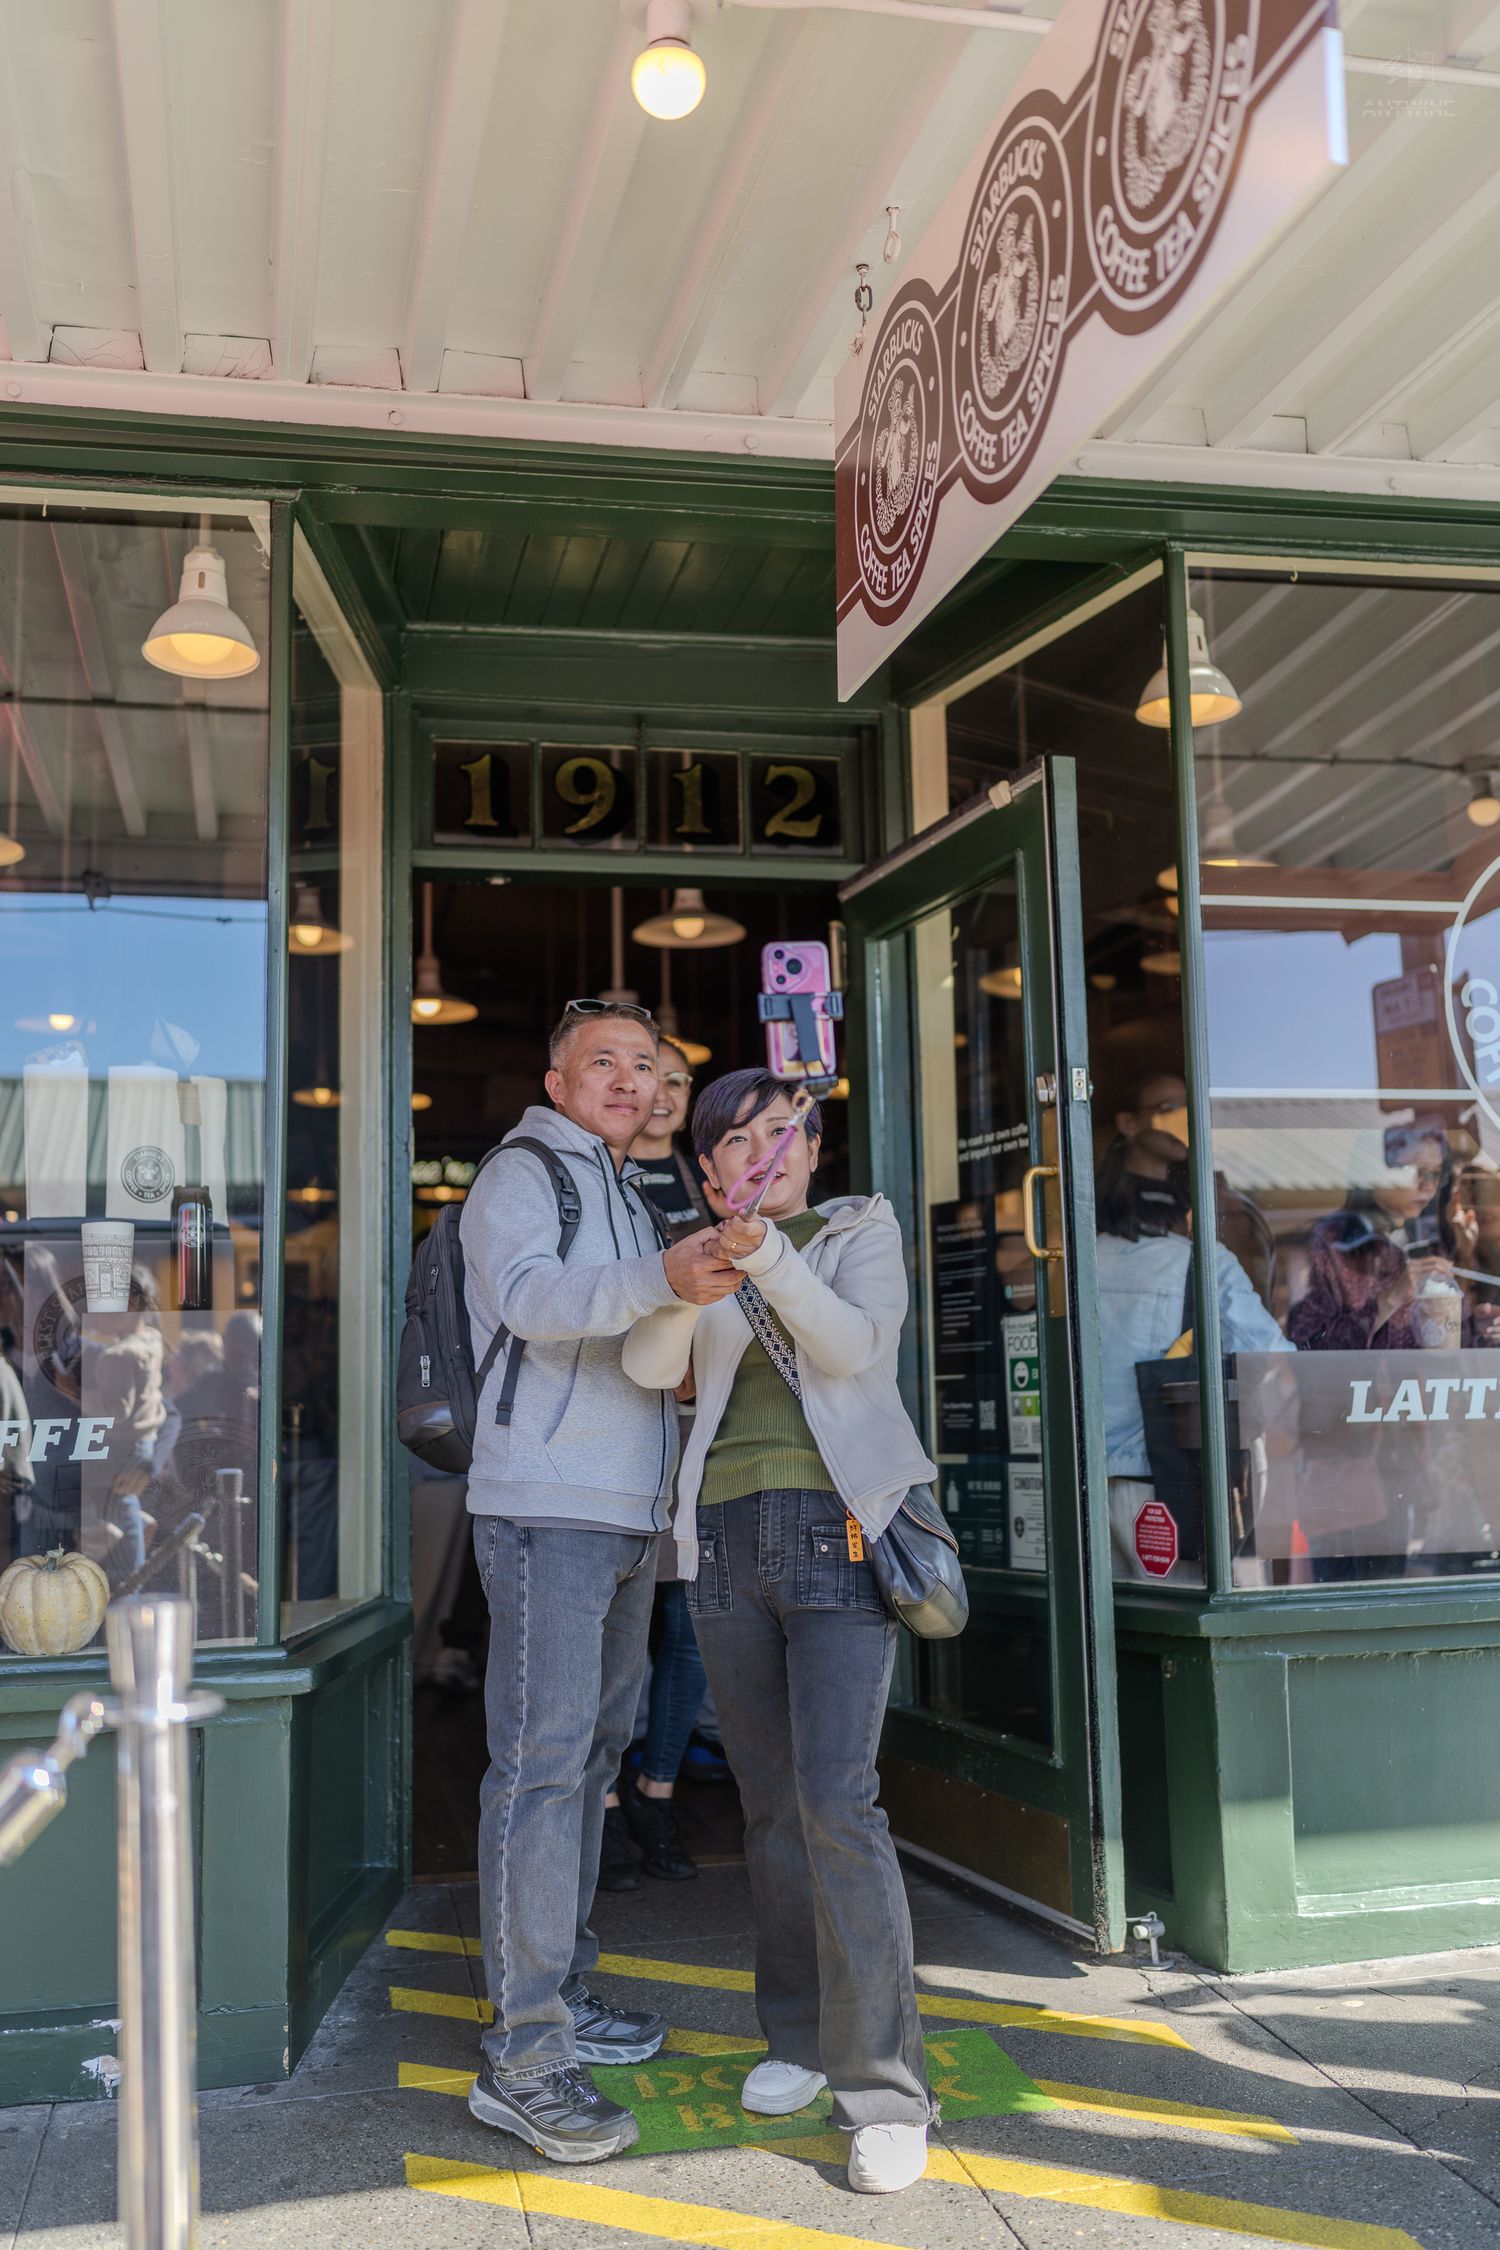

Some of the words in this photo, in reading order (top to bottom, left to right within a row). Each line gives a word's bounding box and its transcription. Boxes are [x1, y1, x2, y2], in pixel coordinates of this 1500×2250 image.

[970, 138, 1047, 271] STARBUCKS
[1096, 204, 1151, 293] COFFEE
[1153, 210, 1195, 281] TEA
[1192, 34, 1248, 215] SPICES
[868, 319, 924, 422] STARBUCKS
[960, 390, 998, 469] COFFEE
[1001, 409, 1029, 462] TEA
[1027, 274, 1065, 415] SPICES
[861, 523, 889, 595] COFFEE
[890, 548, 911, 592] TEA
[910, 440, 937, 549] SPICES
[458, 753, 823, 839] 1912
[1461, 978, 1500, 1083] COF
[1346, 1377, 1500, 1423] LATT
